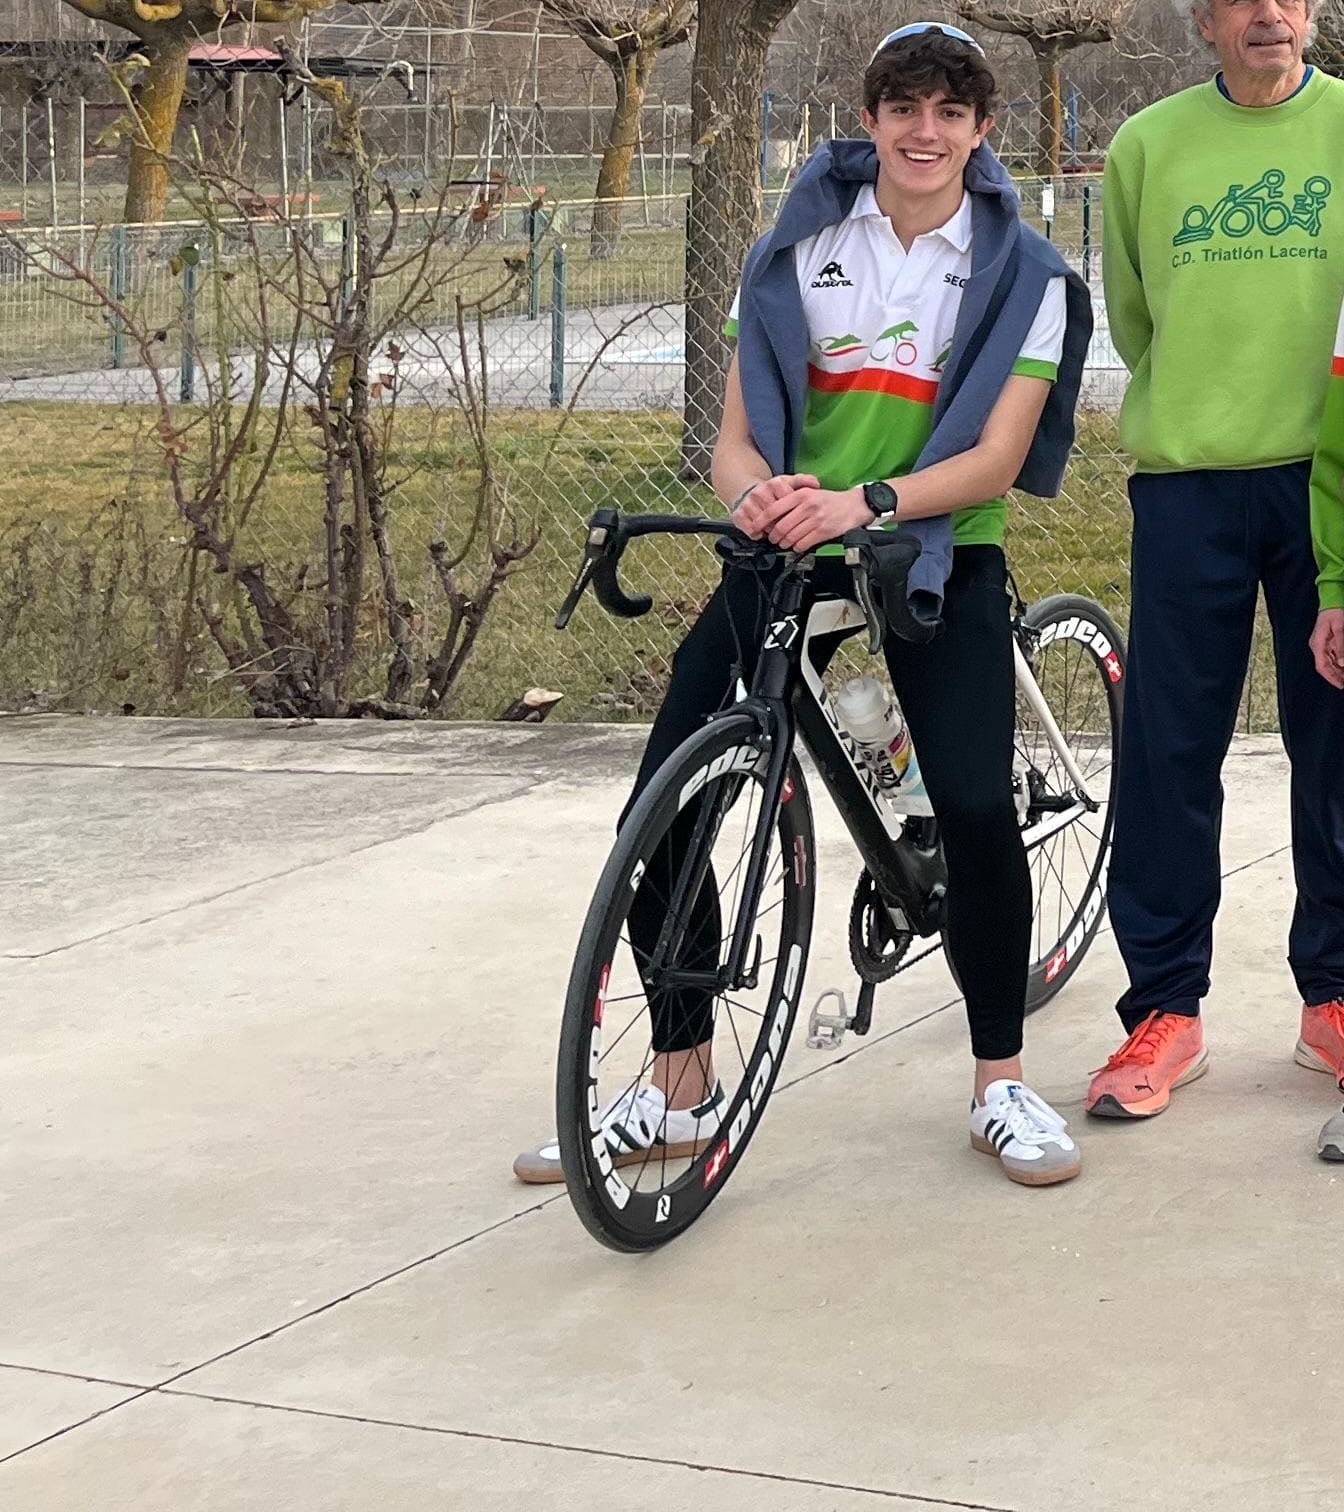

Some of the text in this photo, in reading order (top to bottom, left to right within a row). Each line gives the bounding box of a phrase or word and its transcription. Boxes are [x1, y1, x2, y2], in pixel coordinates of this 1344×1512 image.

[1172, 245, 1328, 268] C.D. Triatlón Lacerta
